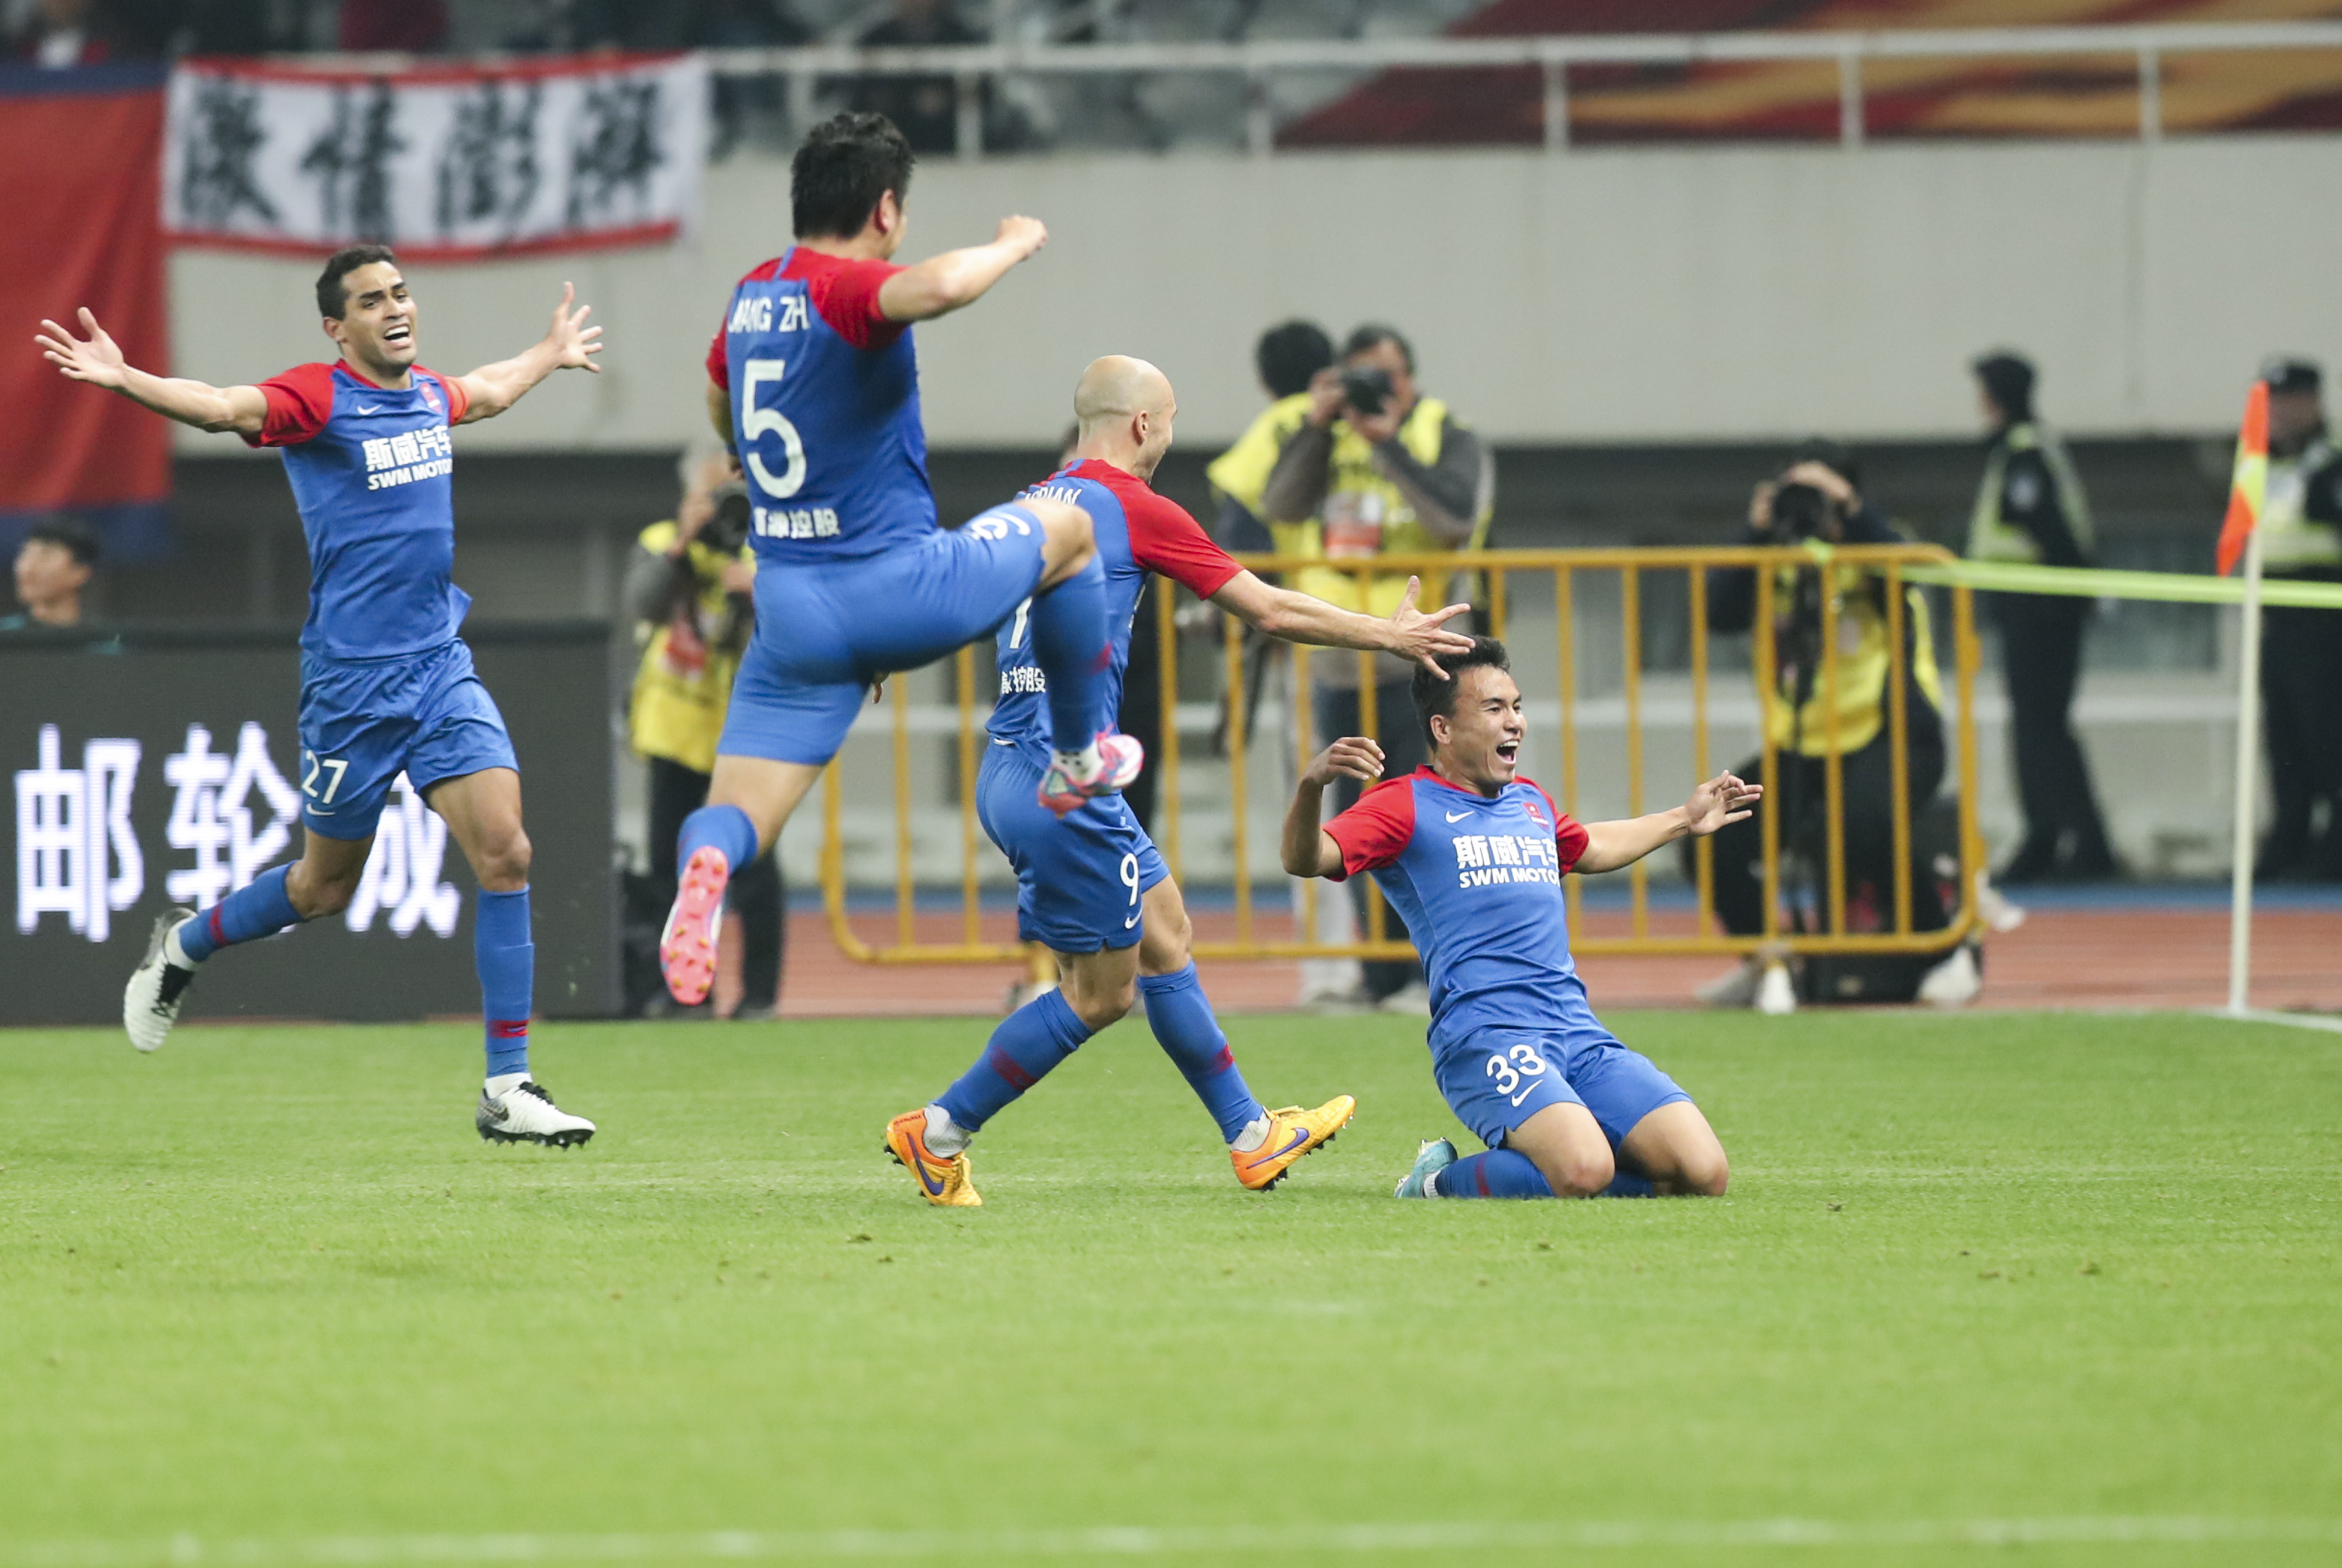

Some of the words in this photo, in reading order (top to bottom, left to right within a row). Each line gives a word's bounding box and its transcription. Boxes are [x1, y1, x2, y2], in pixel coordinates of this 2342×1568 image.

[362, 425, 453, 472] 斯威汽车
[742, 359, 807, 499] 5
[367, 467, 413, 491] SWM
[412, 458, 453, 481] MOTO
[302, 749, 349, 804] 27
[1120, 853, 1139, 906] 9
[1459, 868, 1511, 889] SWM
[1486, 1044, 1546, 1095] 33
